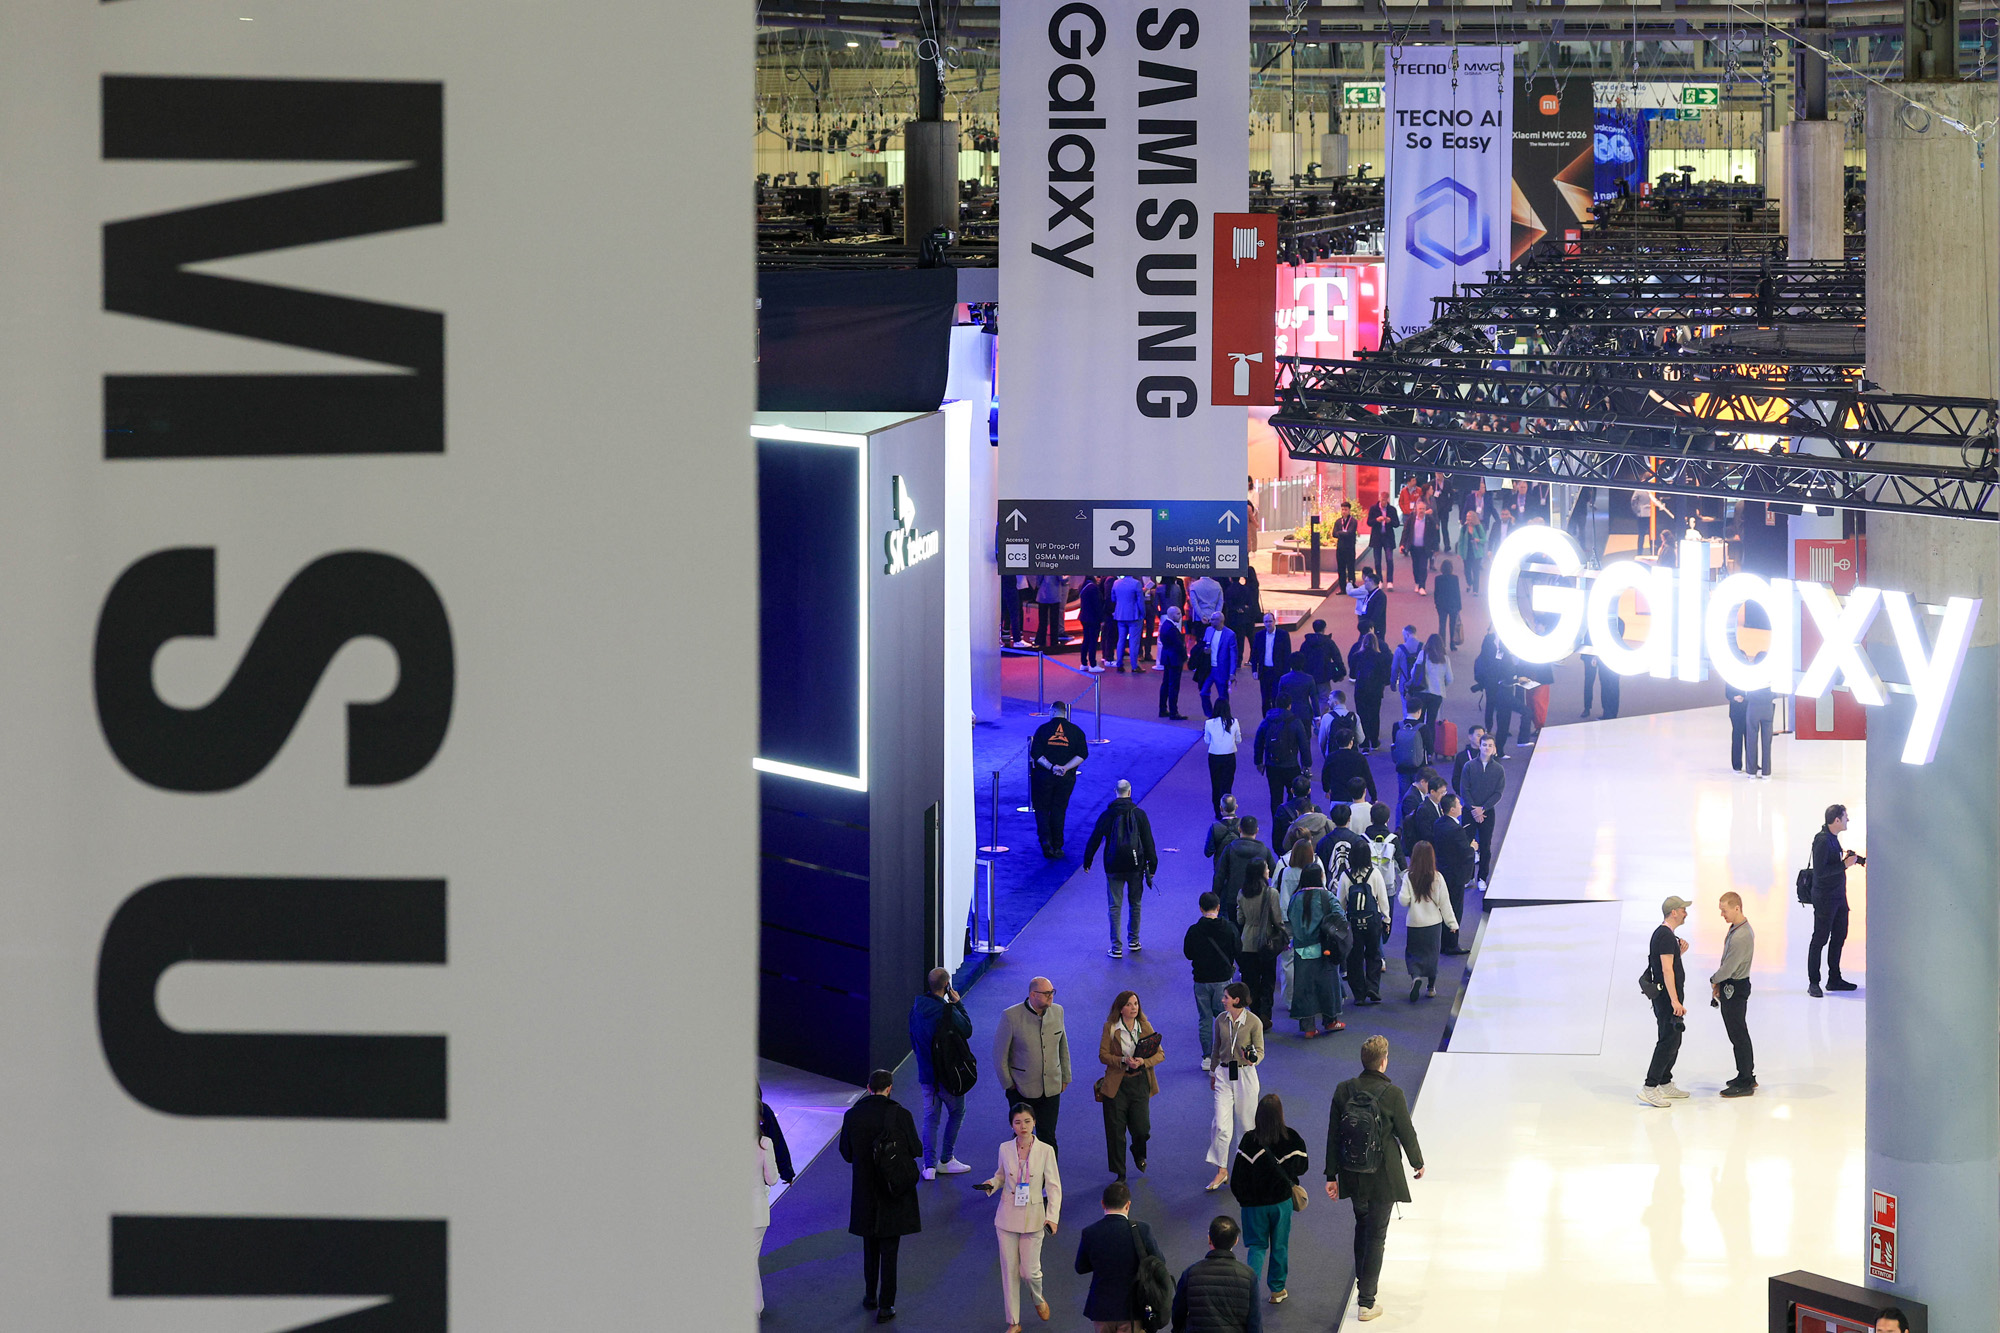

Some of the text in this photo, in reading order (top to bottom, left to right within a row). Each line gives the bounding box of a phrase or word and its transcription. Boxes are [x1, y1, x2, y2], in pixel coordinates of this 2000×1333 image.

[1399, 63, 1447, 75] TECNO
[1464, 62, 1500, 72] MWC
[1396, 109, 1502, 127] TECNO AI
[1512, 130, 1588, 139] Xiaomi MWC 2026
[1031, 2, 1107, 279] Galaxy
[1405, 132, 1492, 153] So Easy
[1136, 7, 1200, 419] SAMSUNG
[1109, 519, 1137, 557] 3
[1188, 538, 1211, 546] GSMA
[886, 527, 939, 576] SK telecom
[1048, 543, 1081, 551] Drop-Off
[1165, 545, 1211, 554] Insights Hub
[1007, 552, 1028, 561] CC3
[1035, 553, 1080, 561] GSMA Media
[1191, 555, 1211, 563] MWC
[1217, 553, 1238, 563] CC2
[1035, 561, 1059, 570] Village
[1165, 562, 1211, 570] Roundtables
[1488, 524, 1982, 766] Galaxy
[93, 0, 457, 1333] MSU
[1871, 1268, 1893, 1280] EXTINTOR
